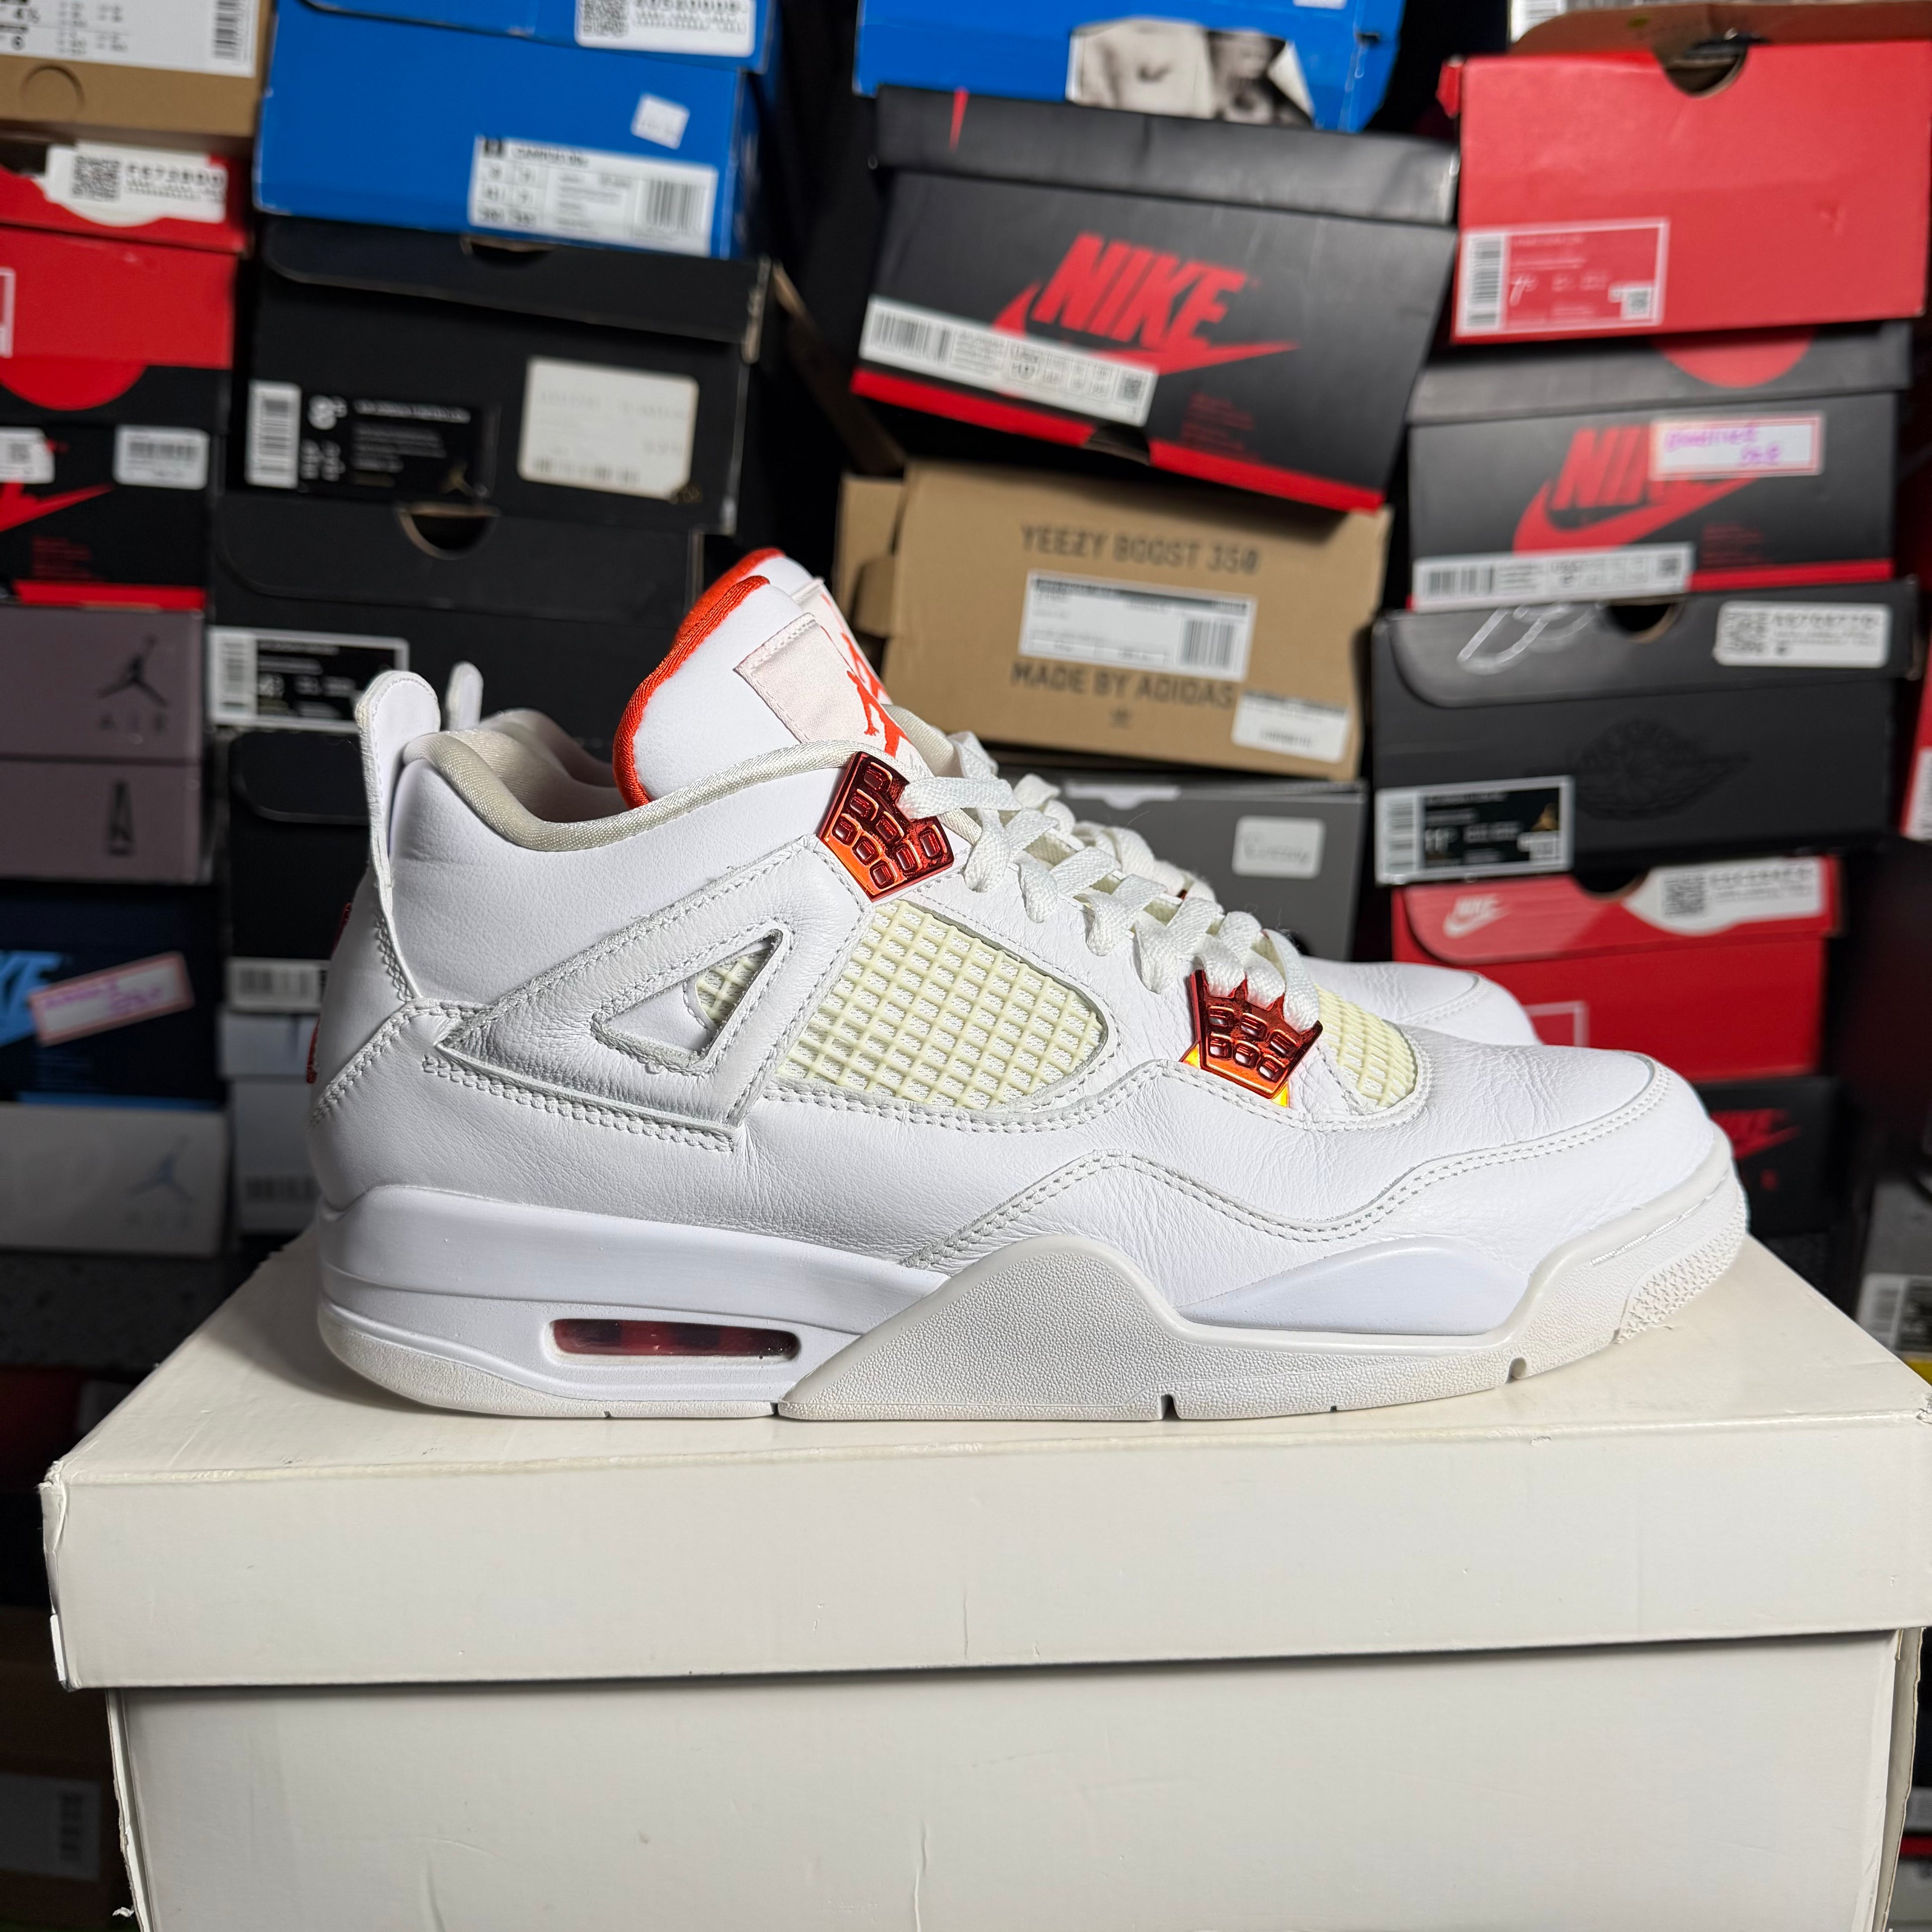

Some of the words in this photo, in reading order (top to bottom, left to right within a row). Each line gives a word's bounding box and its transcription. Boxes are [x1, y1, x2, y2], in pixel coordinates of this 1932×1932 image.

[1031, 231, 1247, 354] NIKE
[1022, 526, 1108, 560] YEEZY
[1112, 533, 1199, 569] BOOST
[1010, 662, 1084, 694] MADE
[1094, 672, 1128, 698] BY
[1136, 675, 1234, 709] ADIDAS
